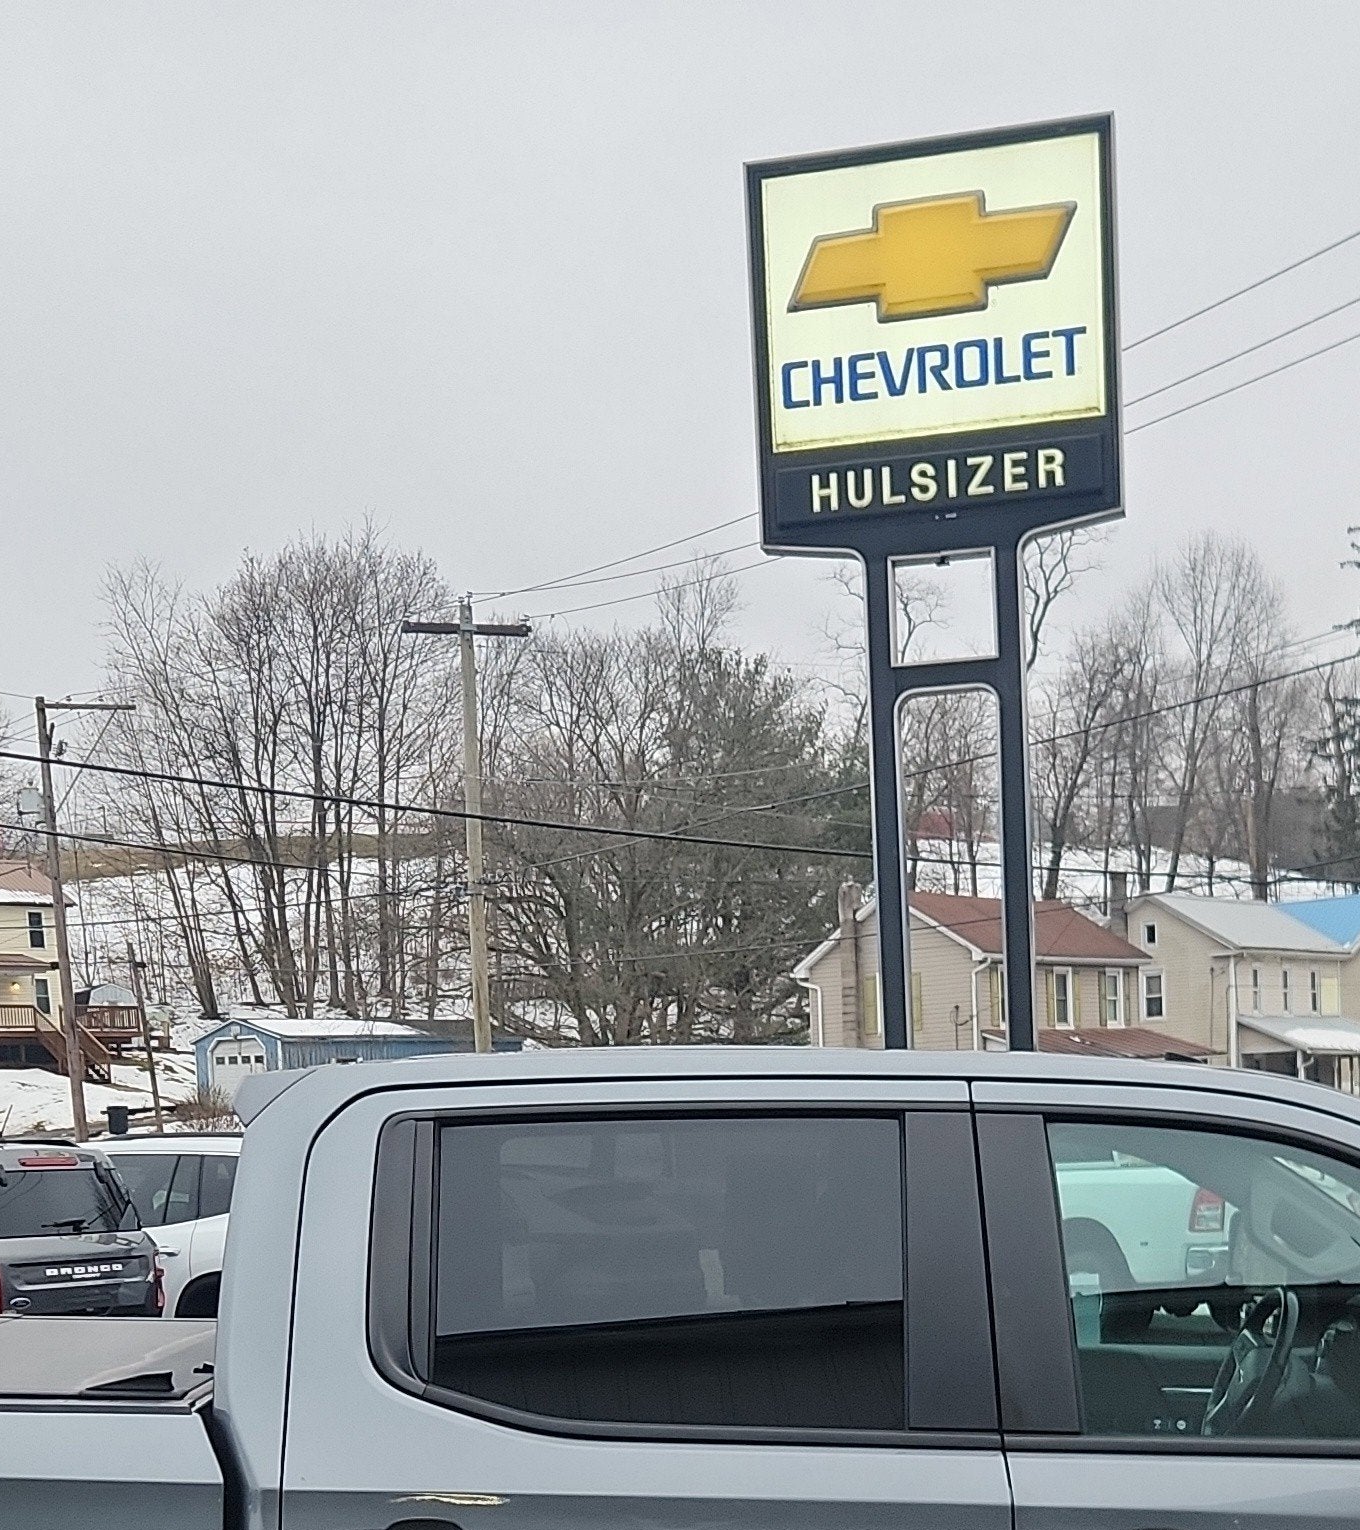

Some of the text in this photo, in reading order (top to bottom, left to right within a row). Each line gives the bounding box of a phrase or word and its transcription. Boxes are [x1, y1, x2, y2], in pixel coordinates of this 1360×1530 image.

[780, 325, 1088, 410] CHEVROLET
[810, 447, 1066, 514] HULSIZER
[45, 1263, 123, 1276] BRONCO
